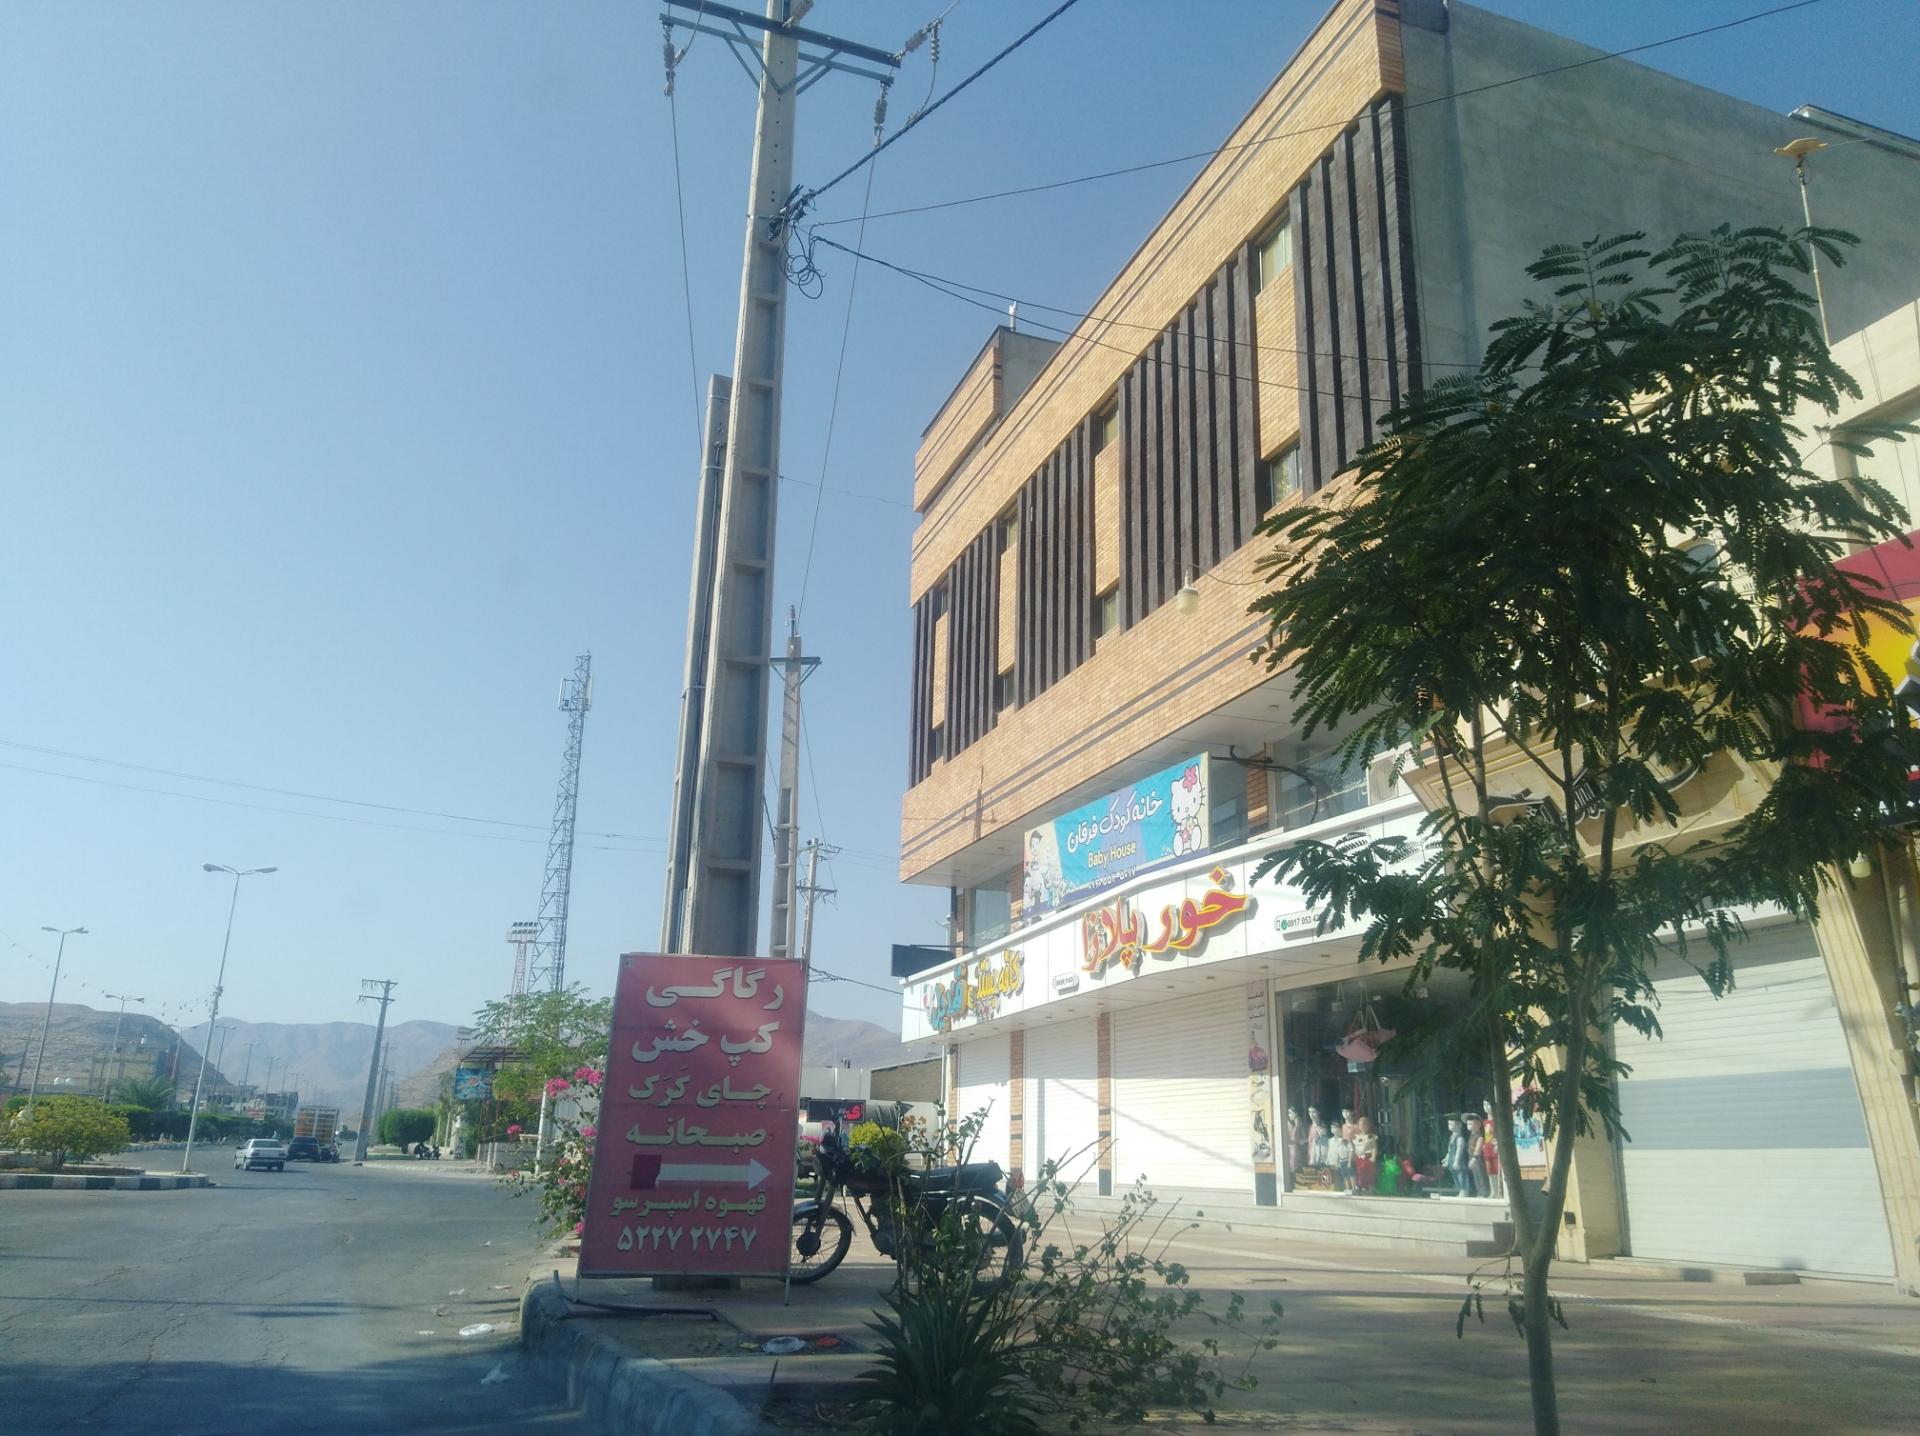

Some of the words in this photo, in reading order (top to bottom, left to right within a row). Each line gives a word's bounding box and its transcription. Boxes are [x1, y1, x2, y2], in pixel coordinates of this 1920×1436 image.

[1100, 791, 1137, 834] کودک
[1132, 790, 1163, 821] خانه
[1067, 815, 1098, 854] فرقان
[1088, 847, 1108, 869] Baby
[1110, 840, 1137, 861] House
[1142, 866, 1249, 954] خور
[1082, 896, 1139, 973] پلازا
[646, 966, 785, 1010] رگاگی
[998, 947, 1022, 993] کافه
[632, 1018, 710, 1062] خش
[696, 1075, 773, 1109] چای
[626, 1116, 768, 1154] صبحانه
[704, 1185, 767, 1218] قهوه
